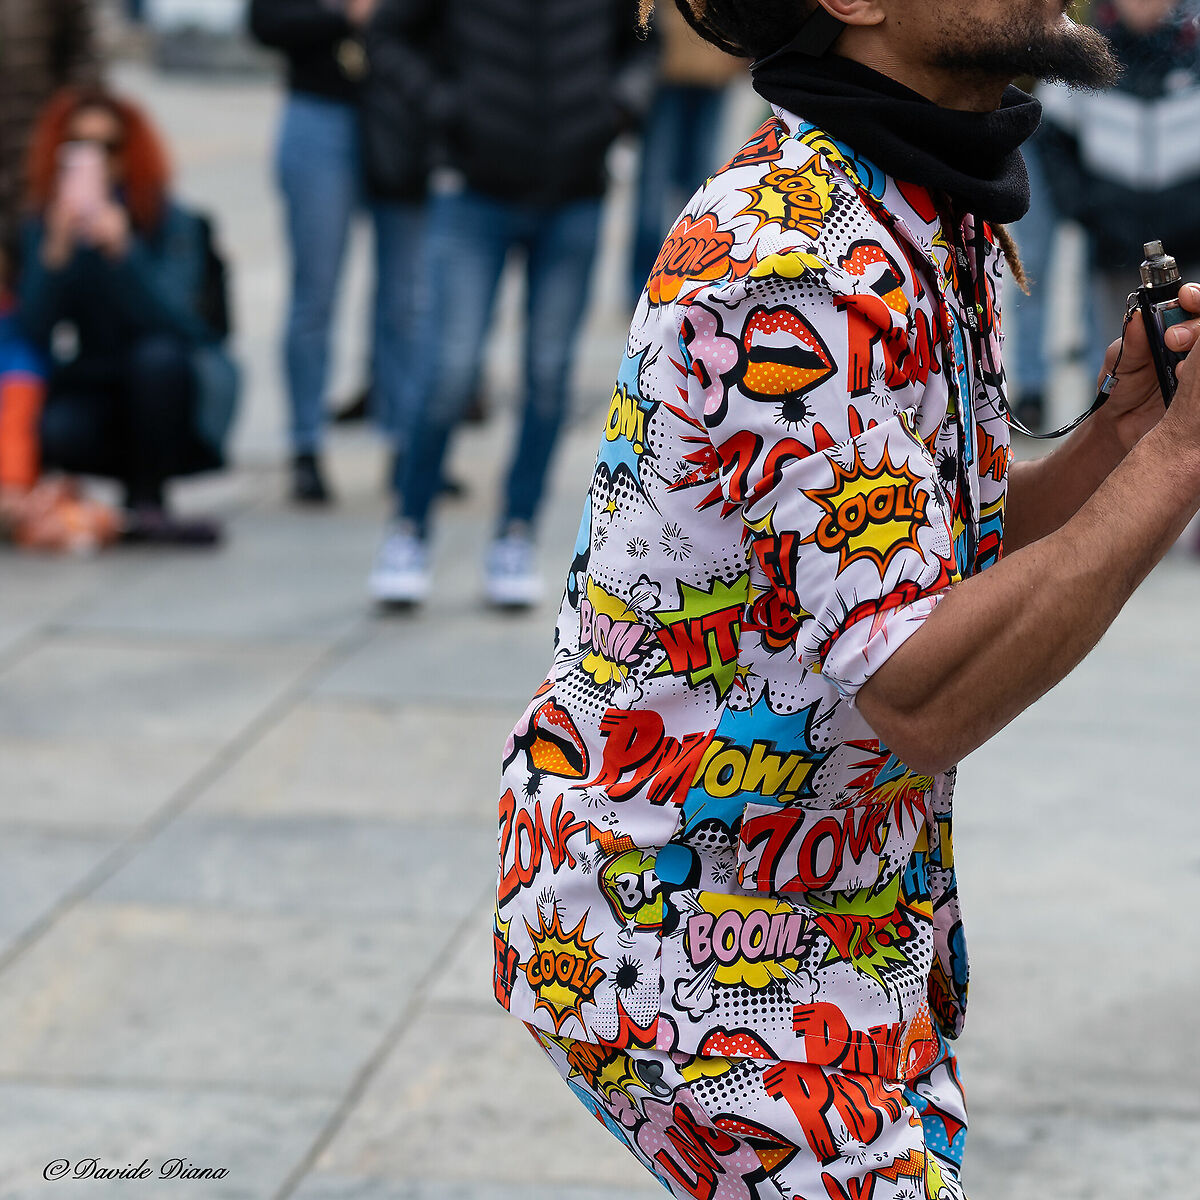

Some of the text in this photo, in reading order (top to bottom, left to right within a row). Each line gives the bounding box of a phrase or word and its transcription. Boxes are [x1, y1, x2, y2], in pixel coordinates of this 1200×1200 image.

[759, 167, 824, 241] COOL!
[604, 380, 647, 455] OW!
[815, 483, 930, 553] COOL!
[499, 787, 589, 909] ZONK
[739, 804, 892, 894] ZONK
[525, 948, 608, 1000] COOL!
[686, 908, 814, 969] BOOM!
